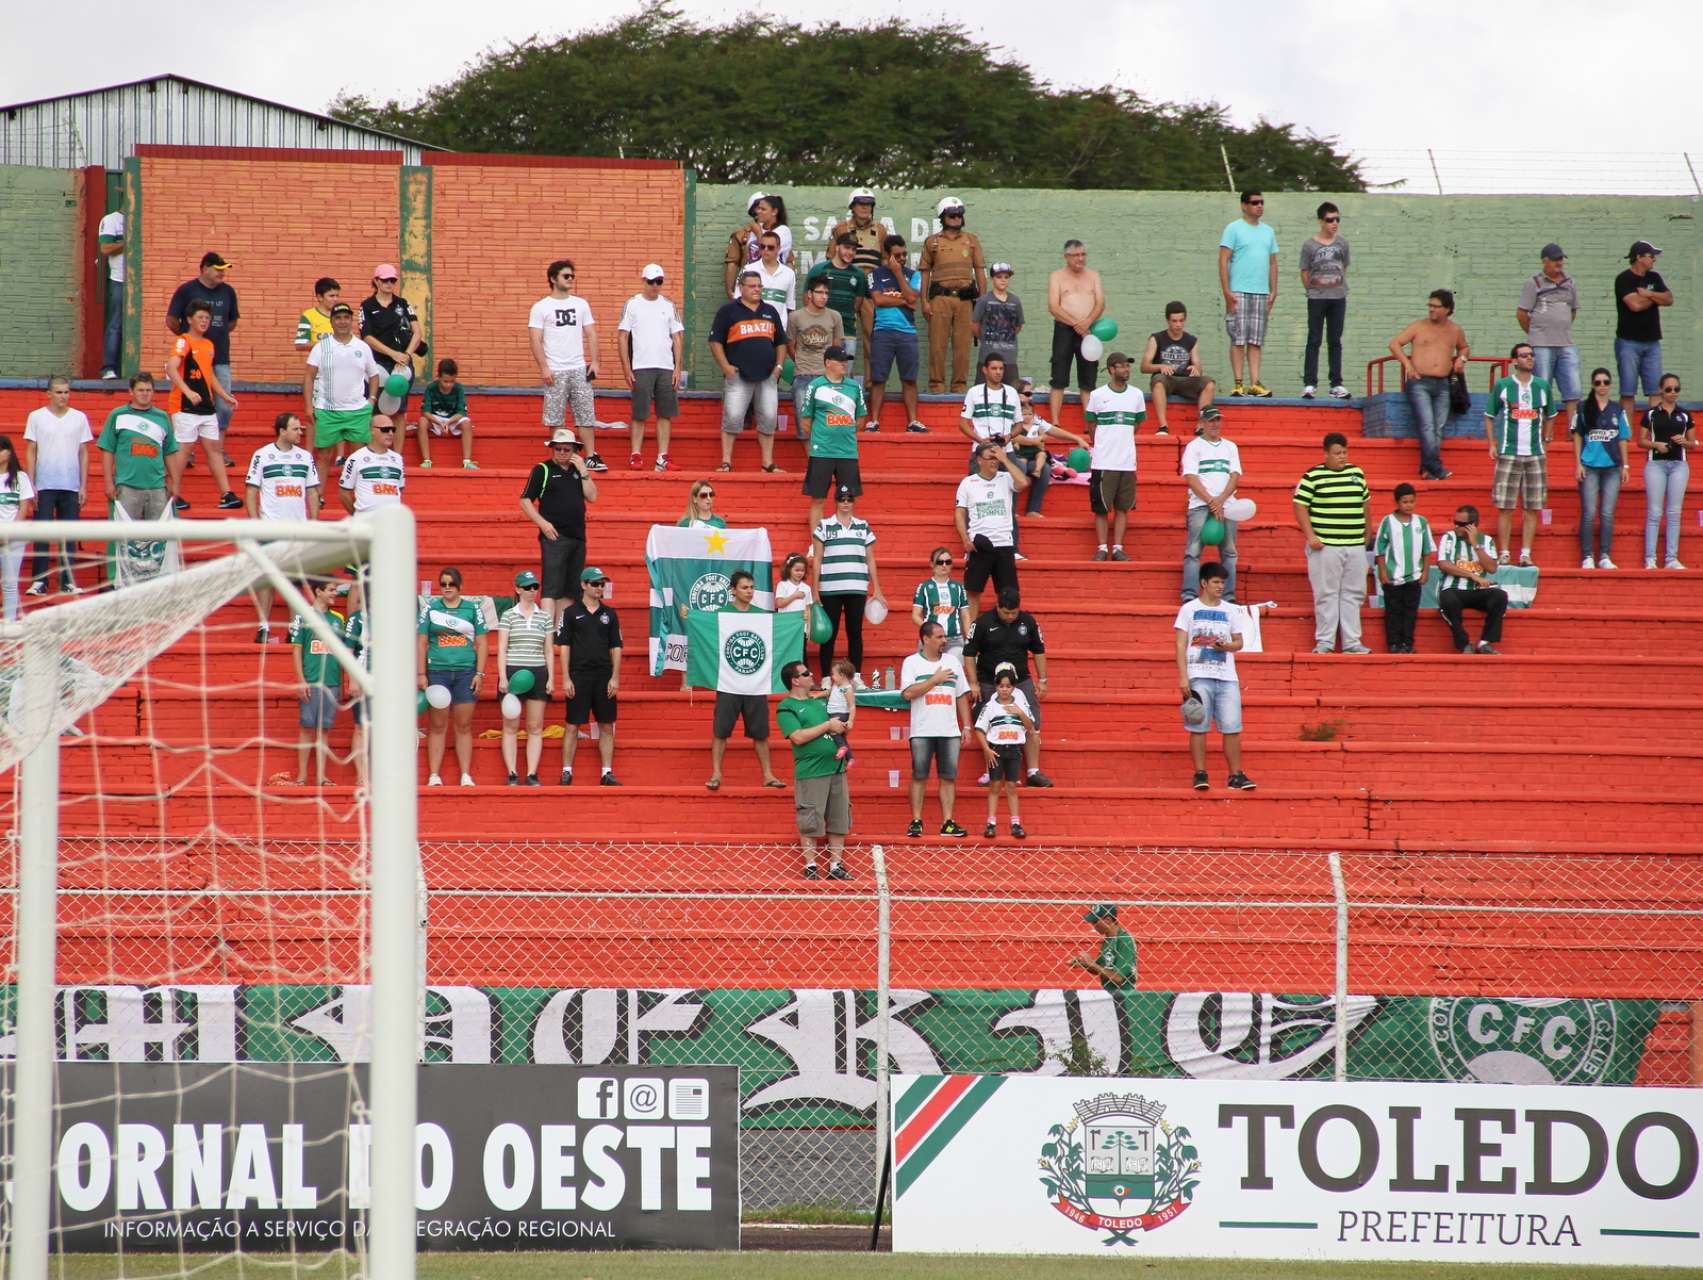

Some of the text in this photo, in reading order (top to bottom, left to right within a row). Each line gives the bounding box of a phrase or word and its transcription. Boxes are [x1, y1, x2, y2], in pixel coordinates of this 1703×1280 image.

[803, 215, 897, 241] SAA
[4, 1122, 317, 1211] ORNAL
[483, 1122, 712, 1211] OESTE
[1218, 1104, 1700, 1200] TOLEDO
[104, 1217, 242, 1242] INFORMAÇÃO
[246, 1220, 260, 1238] A
[264, 1219, 346, 1242] SERVIÇO
[416, 1216, 511, 1241] EGRAÇÃO
[518, 1219, 616, 1238] REGIONAL
[1064, 1205, 1178, 1229] 1946 TOLEDO 1951
[1337, 1210, 1582, 1246] PREFEITURA
